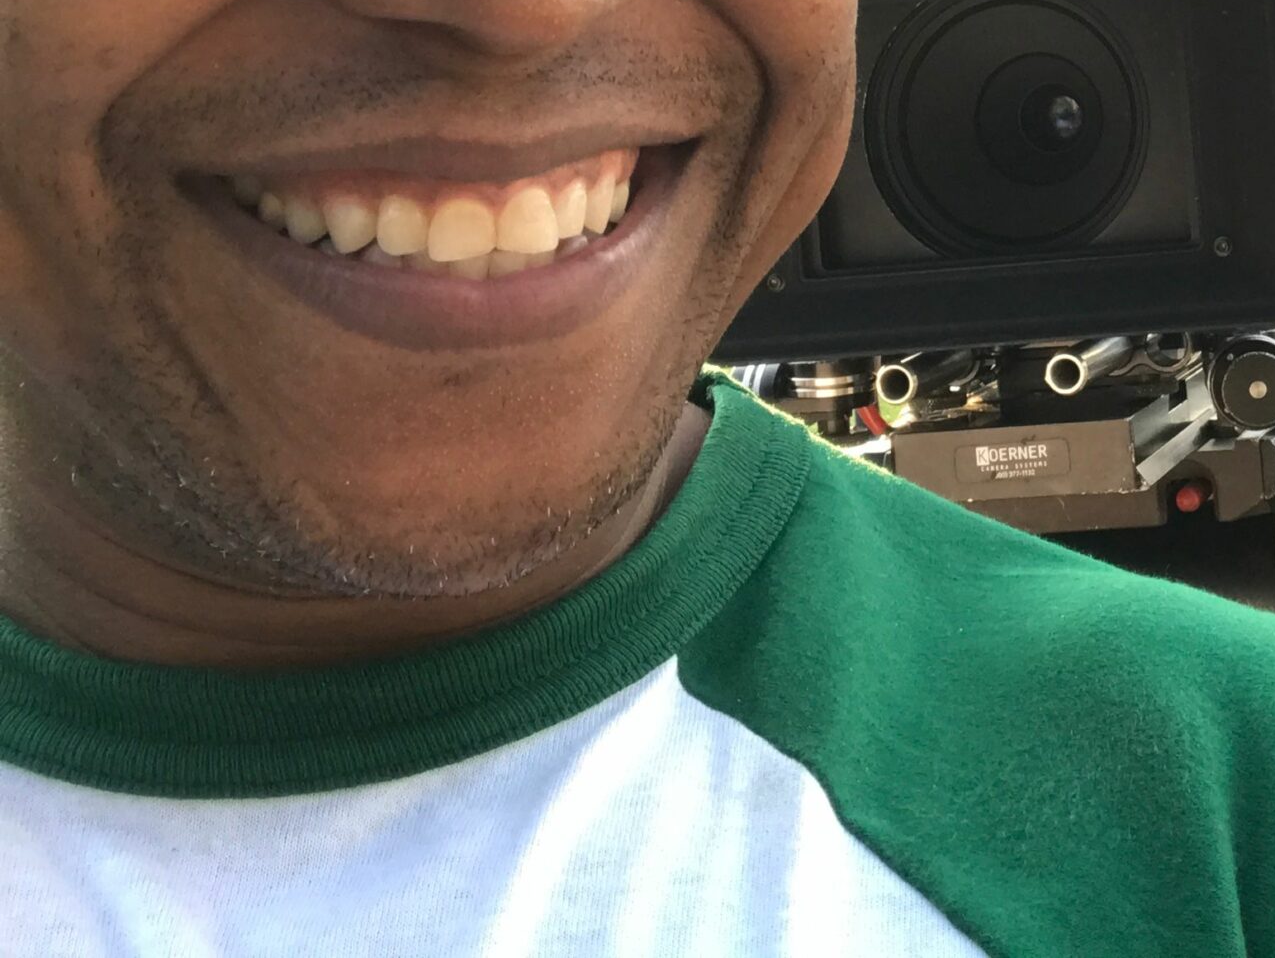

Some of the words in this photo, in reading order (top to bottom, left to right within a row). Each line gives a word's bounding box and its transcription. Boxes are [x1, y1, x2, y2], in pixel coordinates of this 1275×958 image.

[976, 444, 1047, 466] KOERNER
[980, 464, 1009, 472] CAMERA
[1015, 460, 1047, 470] SYSTEMS
